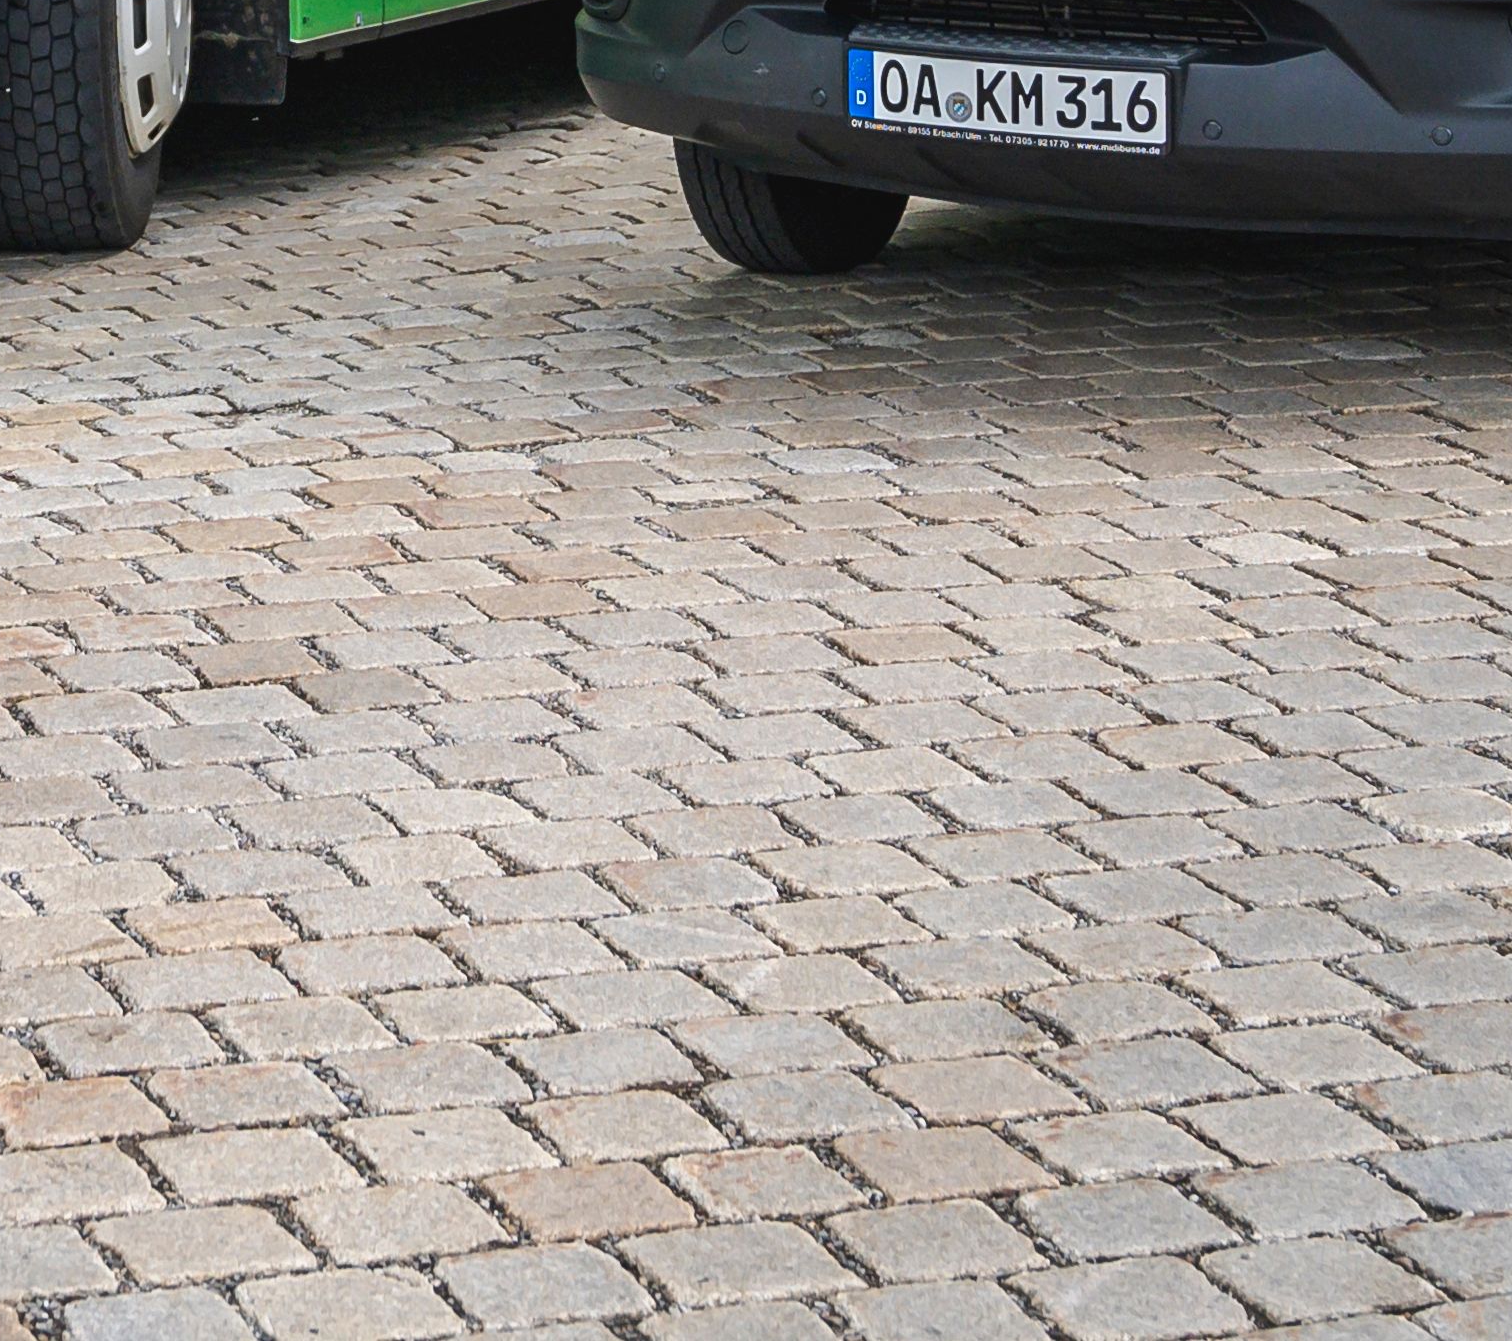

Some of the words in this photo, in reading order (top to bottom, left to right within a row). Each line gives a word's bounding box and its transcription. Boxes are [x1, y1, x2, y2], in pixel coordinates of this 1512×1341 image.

[856, 90, 867, 105] D
[880, 59, 942, 119] OA
[976, 68, 1044, 127] KM
[1056, 74, 1158, 134] 316
[933, 129, 982, 141] Erbach/Ulm
[1076, 142, 1161, 155] www.midibusse.de
